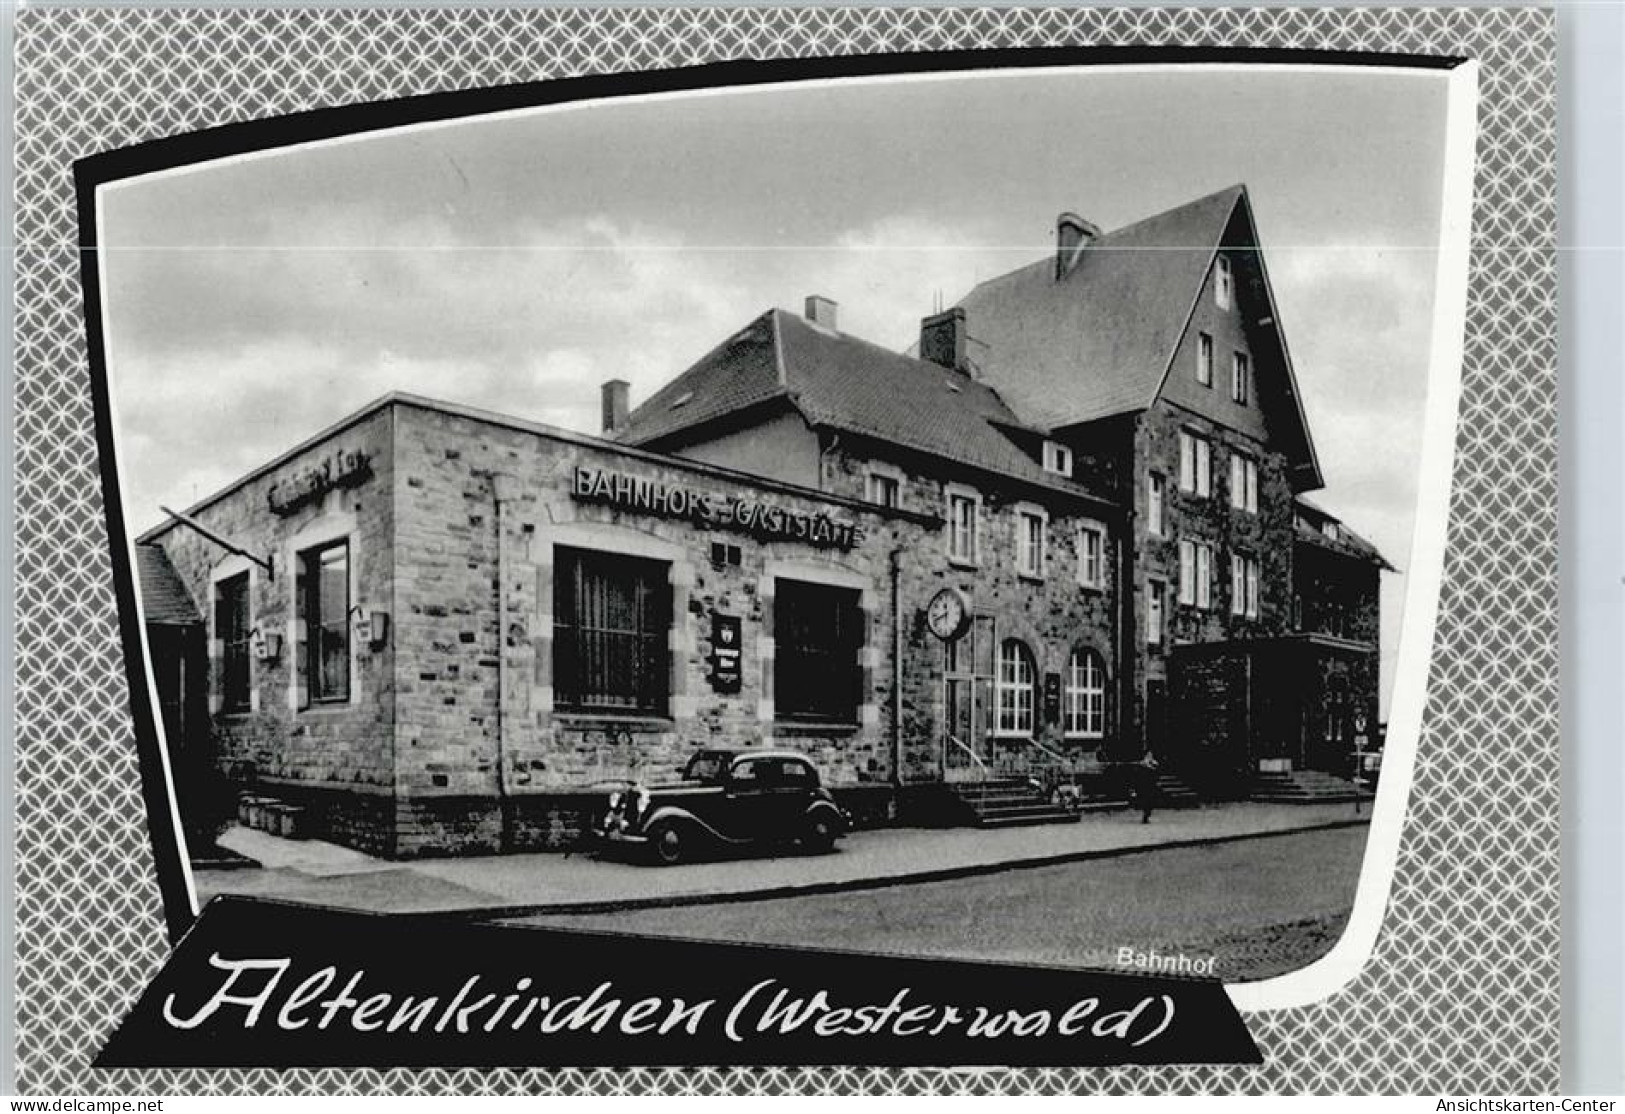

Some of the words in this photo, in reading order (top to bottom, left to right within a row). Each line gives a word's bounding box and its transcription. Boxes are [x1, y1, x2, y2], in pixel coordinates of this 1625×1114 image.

[1117, 946, 1216, 975] Bahnhof
[163, 951, 715, 1036] Altenkirchen
[725, 977, 1175, 1045] (Westerwald)
